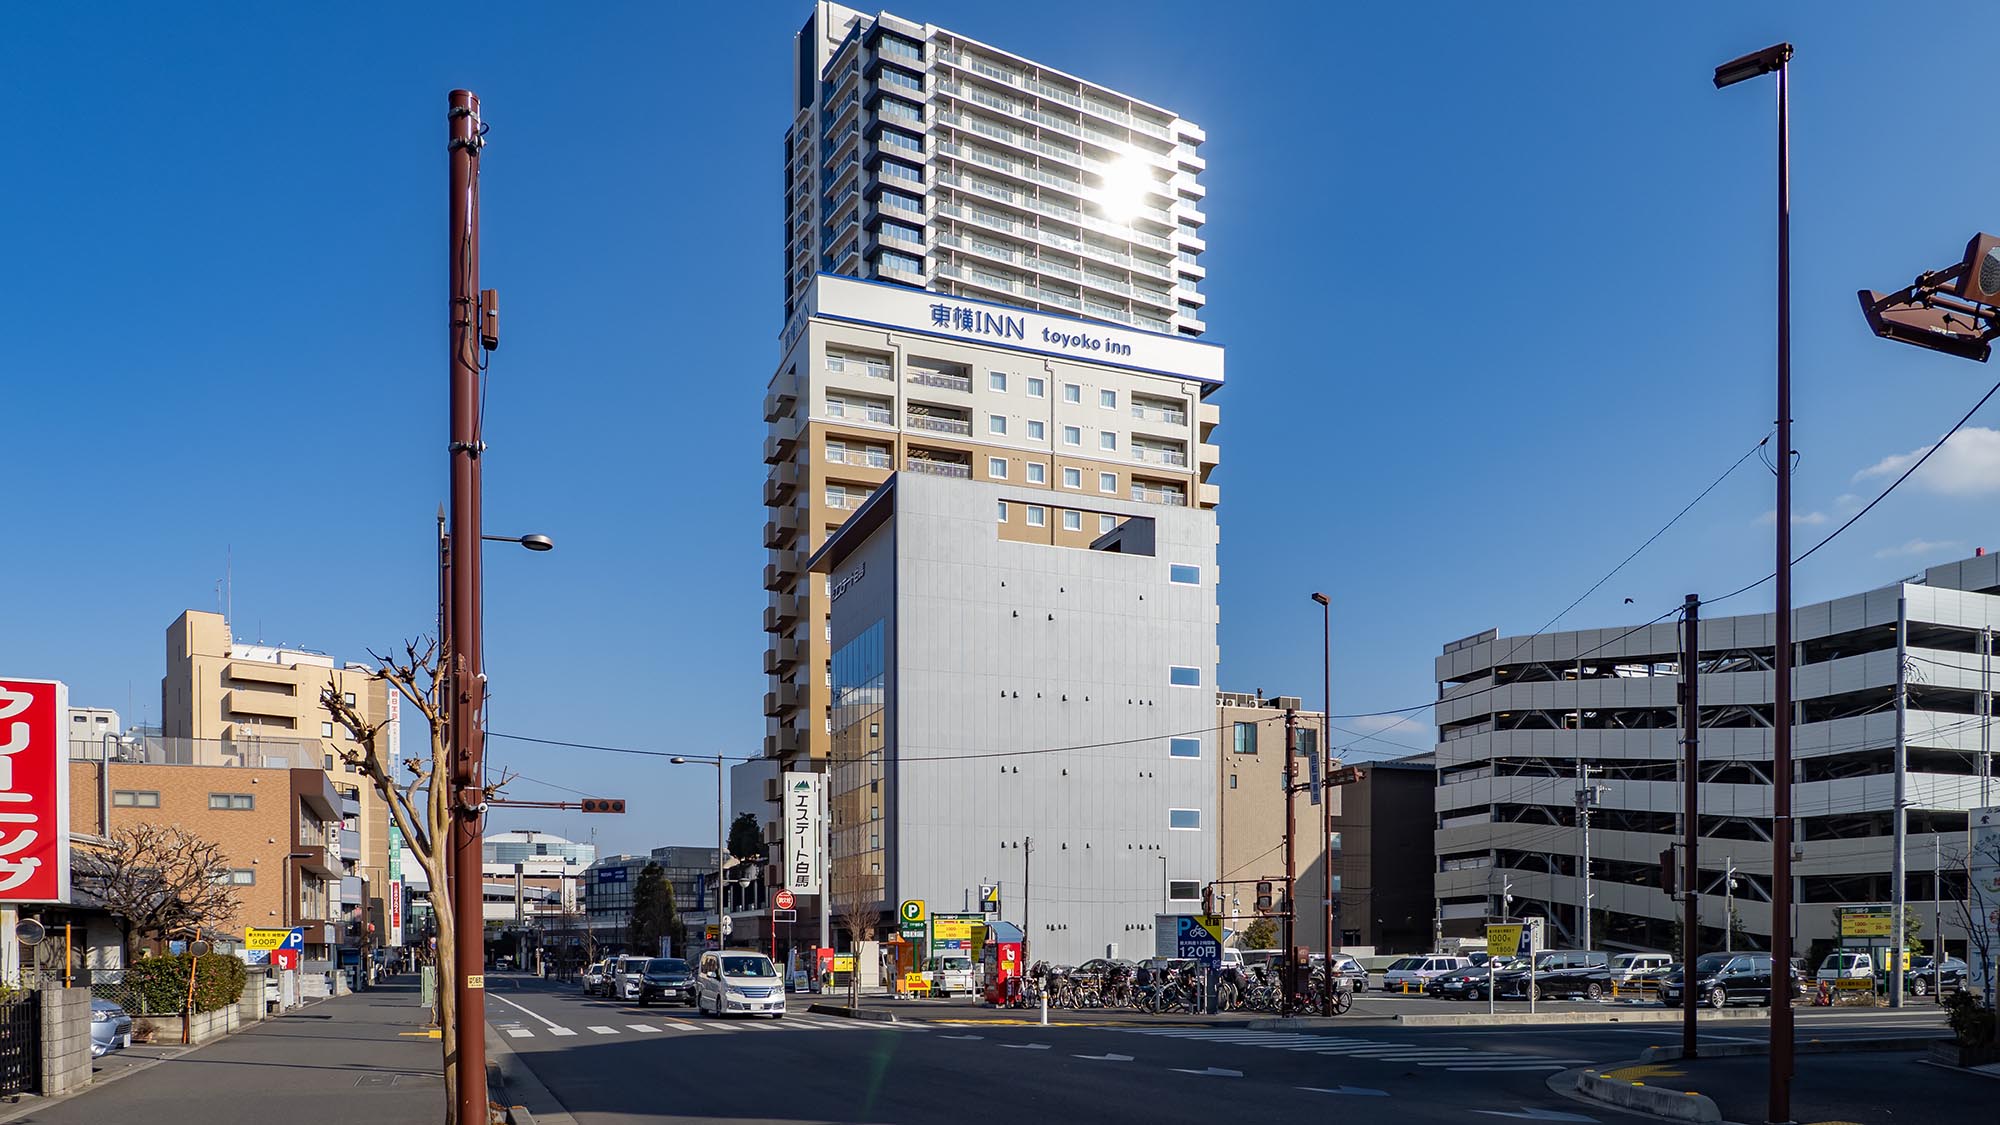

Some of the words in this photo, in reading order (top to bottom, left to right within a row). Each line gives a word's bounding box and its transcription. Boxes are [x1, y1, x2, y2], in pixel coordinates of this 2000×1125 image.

[929, 303, 1025, 340] 東横INN
[1041, 326, 1101, 350] toyoko
[1105, 337, 1131, 356] inn
[795, 795, 809, 888] エステート白馬
[982, 887, 991, 900] P
[908, 904, 918, 918] P
[1178, 918, 1191, 936] P
[252, 938, 277, 946] 900円
[290, 932, 302, 947] P
[1521, 931, 1530, 949] P
[1179, 946, 1217, 958] 120円
